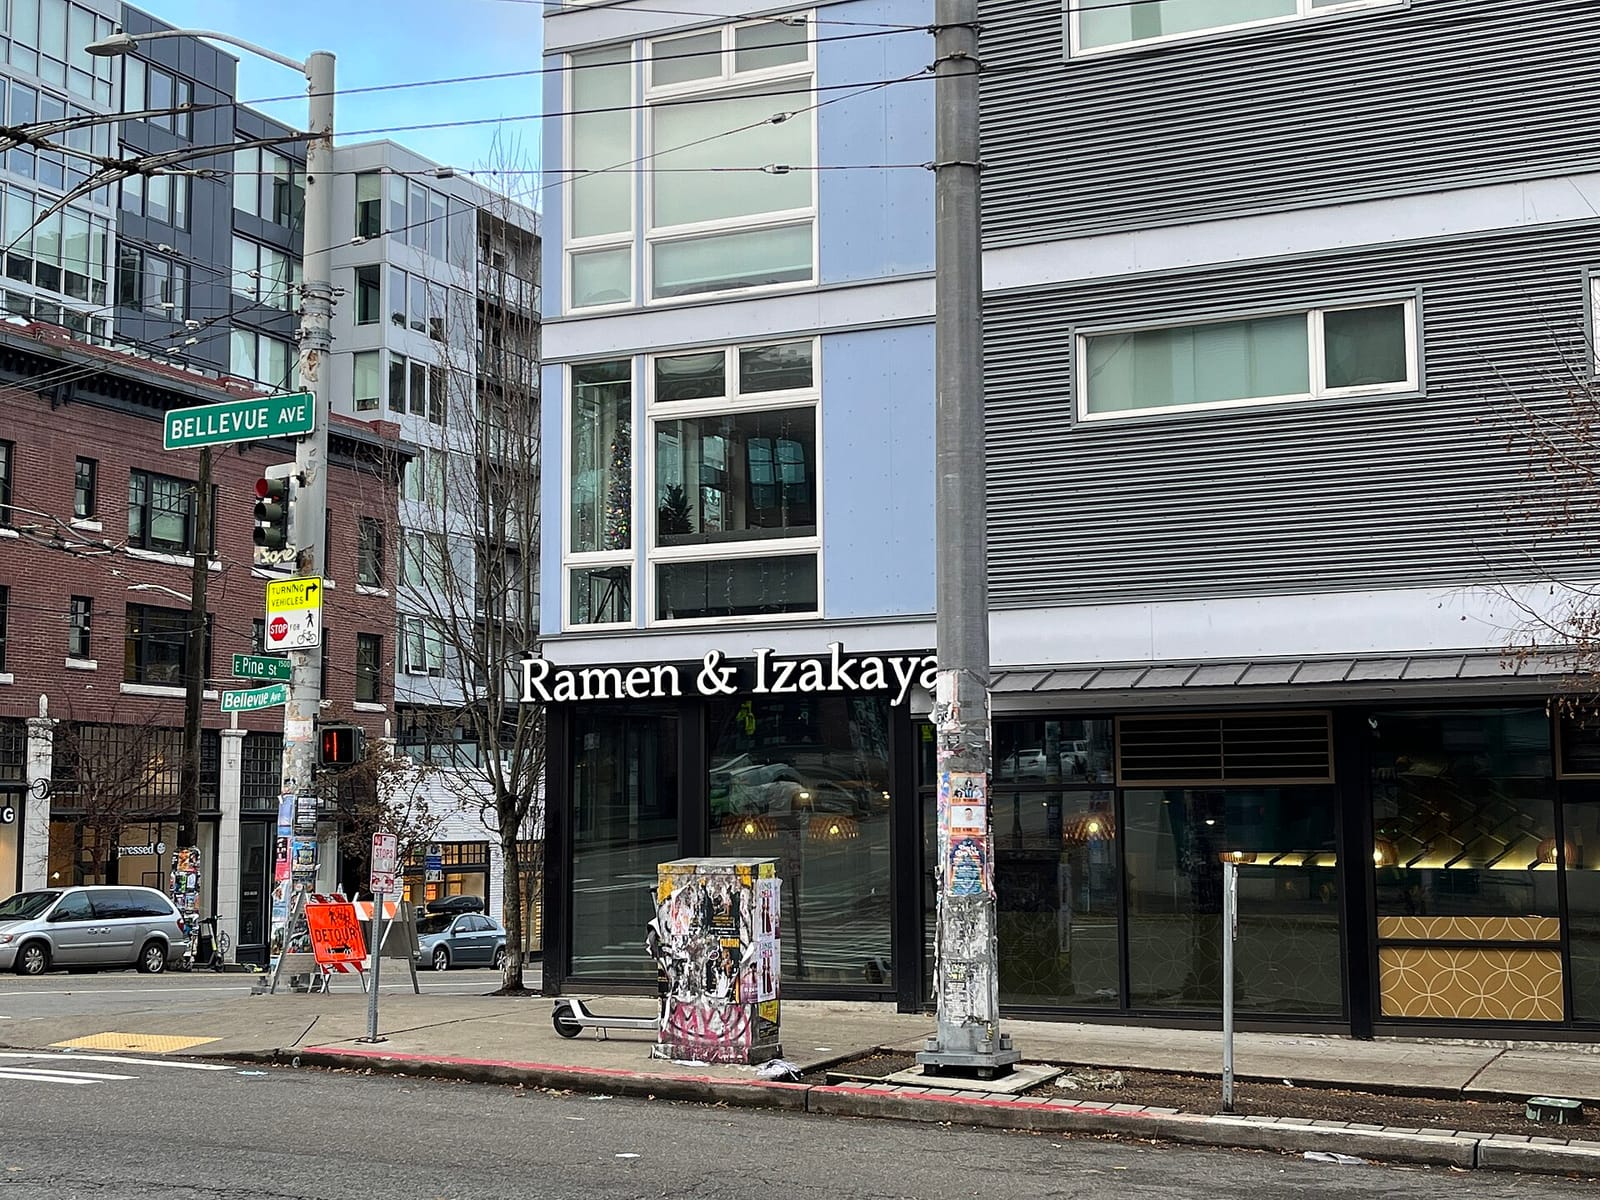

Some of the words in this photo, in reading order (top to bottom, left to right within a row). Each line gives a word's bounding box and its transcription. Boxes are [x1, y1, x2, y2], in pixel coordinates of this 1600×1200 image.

[171, 408, 268, 439] BELLEVUE
[278, 406, 306, 424] AVE
[271, 584, 304, 595] TURNING
[271, 596, 304, 607] VEHICLES
[270, 624, 288, 635] STOP
[290, 624, 300, 632] FOR
[235, 661, 240, 672] E
[242, 657, 264, 675] Pine
[268, 664, 277, 676] St
[519, 659, 682, 702] Ramen
[697, 649, 738, 695] &
[752, 642, 938, 707] Izakaya
[224, 692, 269, 708] Bellevue
[270, 691, 281, 703] Ave
[0, 807, 15, 823] G
[118, 841, 155, 858] pressed
[315, 927, 357, 943] DETOUR
